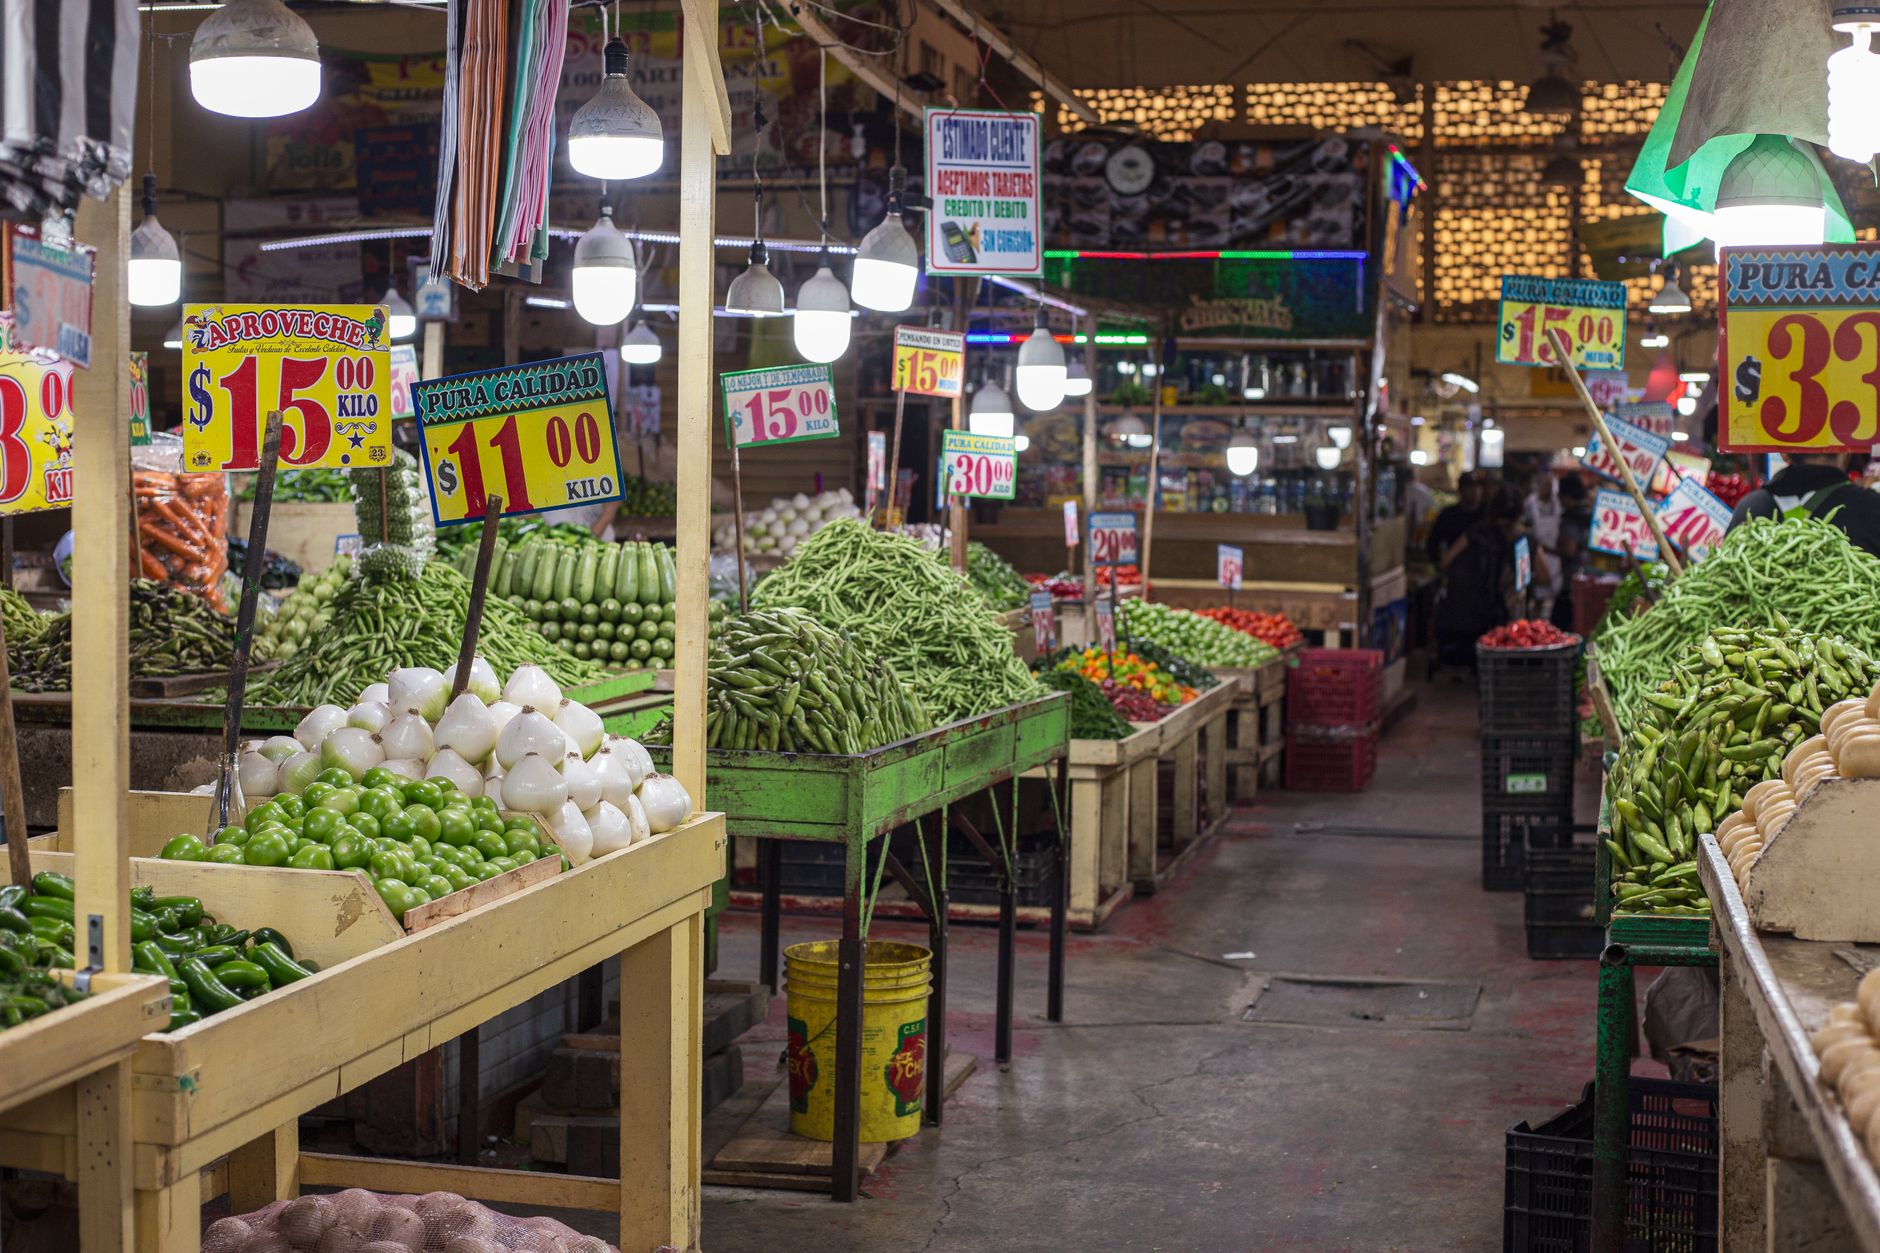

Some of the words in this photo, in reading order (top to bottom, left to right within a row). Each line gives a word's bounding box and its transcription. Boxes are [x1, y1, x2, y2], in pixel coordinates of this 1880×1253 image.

[937, 170, 991, 197] ACEPTAMOS
[991, 172, 1033, 198] TARJETAS
[944, 199, 985, 218] CREDITO
[986, 200, 992, 218] Y
[993, 200, 1028, 219] DEBITO
[1737, 261, 1835, 291] PURA
[1507, 282, 1547, 297] PURA
[1551, 285, 1622, 302] CALIDAD
[208, 310, 366, 350] APROVECHE
[900, 332, 932, 346] PENSANDO
[737, 374, 763, 388] MEJOR
[763, 373, 769, 386] Y
[782, 367, 829, 383] TEMPORADA
[426, 384, 490, 415] PURA
[493, 366, 600, 403] CALIDAD
[337, 393, 379, 418] KILO
[806, 418, 830, 432] KILO
[371, 448, 383, 457] 23
[947, 437, 972, 450] PURA
[973, 439, 1014, 452] CALIDAD
[565, 476, 614, 501] KILO
